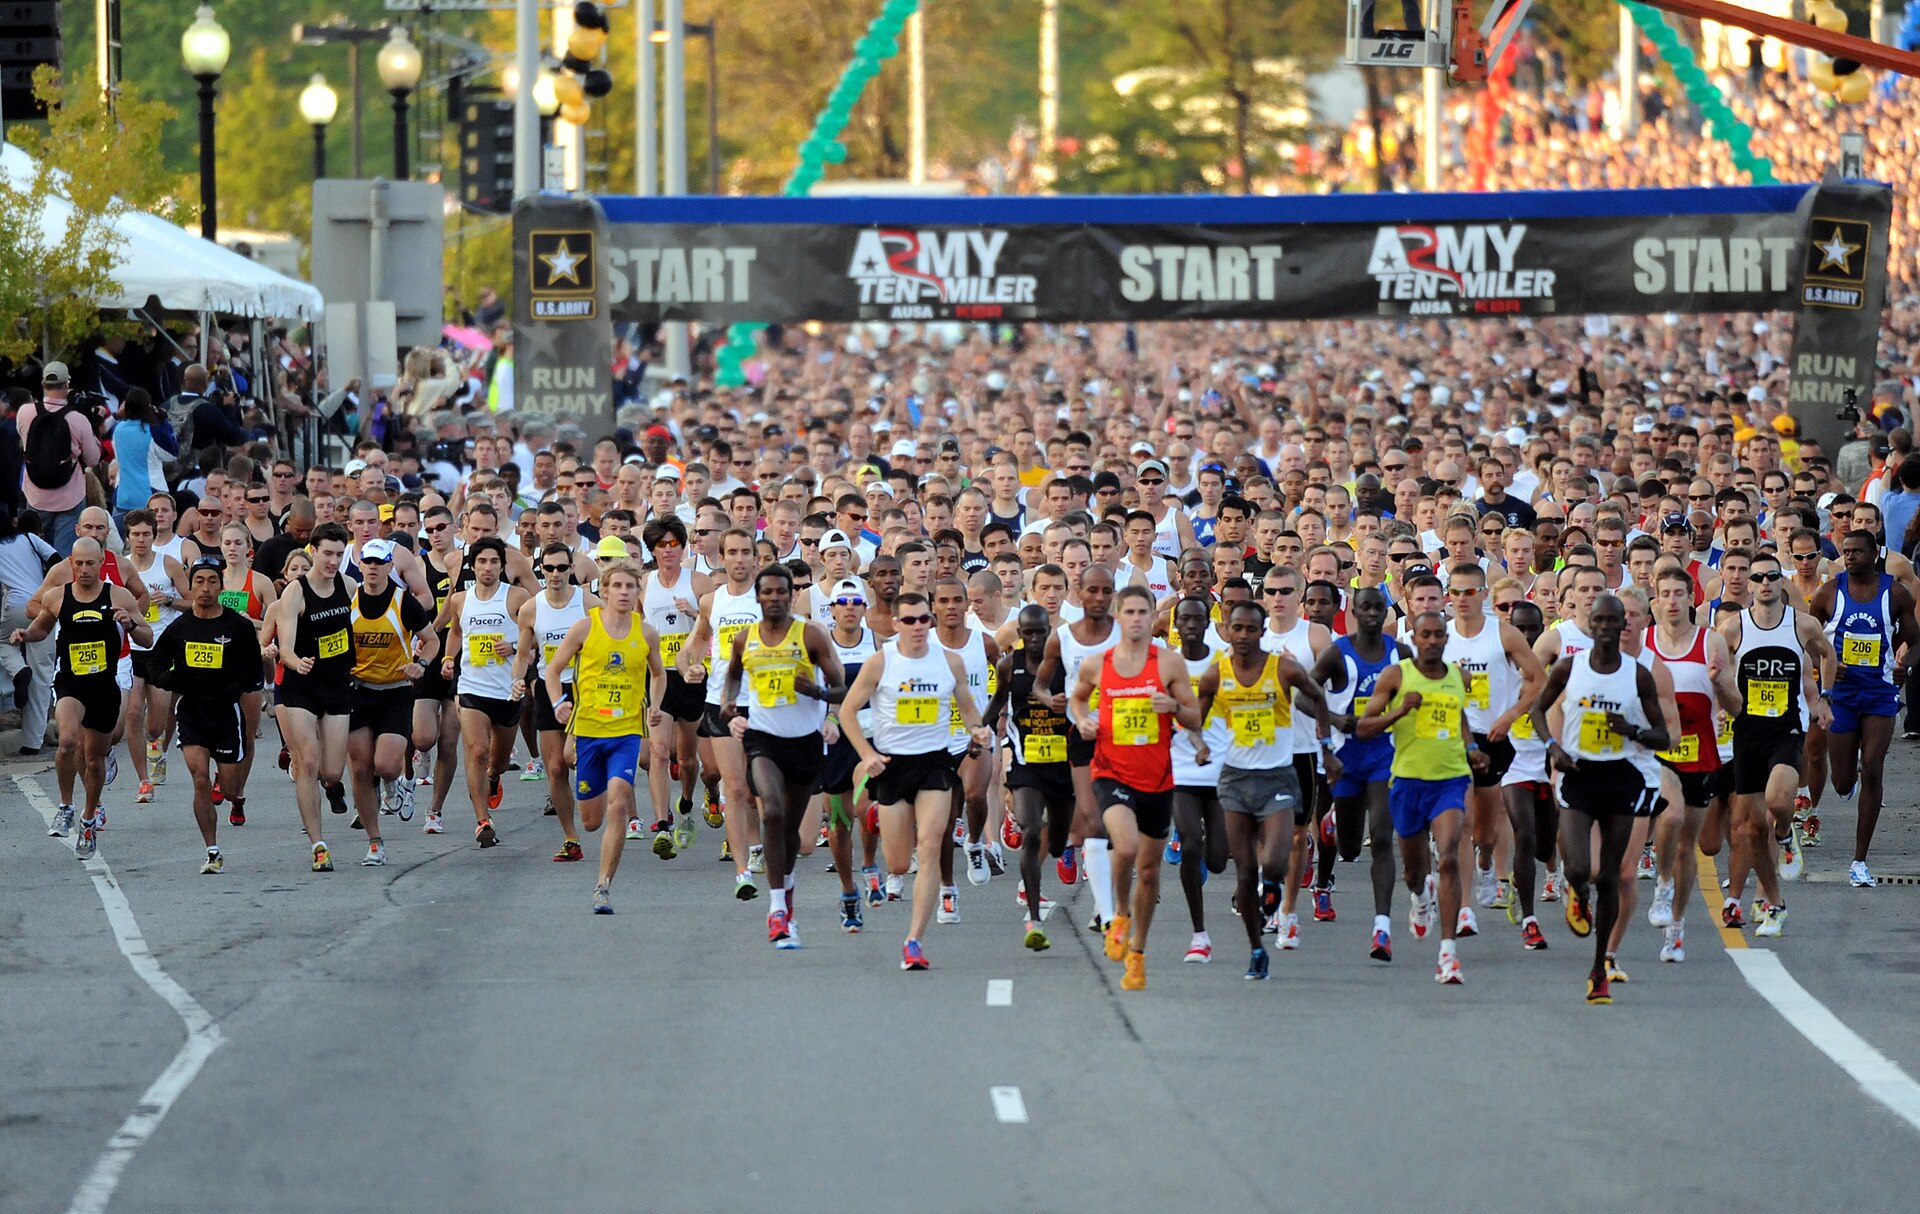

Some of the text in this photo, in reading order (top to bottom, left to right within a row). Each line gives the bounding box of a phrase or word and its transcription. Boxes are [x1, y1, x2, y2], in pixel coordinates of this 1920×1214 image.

[1371, 43, 1415, 58] JLG
[848, 229, 1008, 278] ARMY
[1367, 224, 1527, 274] ARMY
[1633, 238, 1795, 294] START
[608, 247, 757, 303] START
[1120, 245, 1282, 302] START
[855, 276, 1038, 304] TEN-MILER
[1374, 269, 1556, 300] TEN-MILER
[891, 305, 934, 319] AUSA
[1409, 301, 1453, 314] AUSA
[1797, 354, 1857, 379] RUN
[532, 367, 596, 389] RUN
[222, 598, 240, 608] 698
[310, 605, 350, 622] BOWDOIN
[470, 617, 503, 626] Pacers
[719, 617, 755, 626] Pacers
[1845, 612, 1878, 628] FORT BRAGG
[362, 633, 392, 644] TEAM
[546, 632, 566, 641] Pac
[328, 638, 343, 652] 237
[480, 642, 492, 652] 29
[668, 642, 680, 652] 40
[1852, 642, 1872, 653] 206
[78, 650, 98, 662] 256
[194, 651, 214, 663] 235
[768, 679, 781, 690] 47
[608, 691, 620, 702] 73
[1761, 690, 1774, 702] 66
[915, 707, 920, 718] 1
[1030, 710, 1048, 718] FORT
[1432, 710, 1446, 723] 48
[1124, 716, 1147, 728] 312
[1246, 720, 1260, 732] 45
[1596, 728, 1609, 740] 11
[1039, 745, 1051, 757] 41
